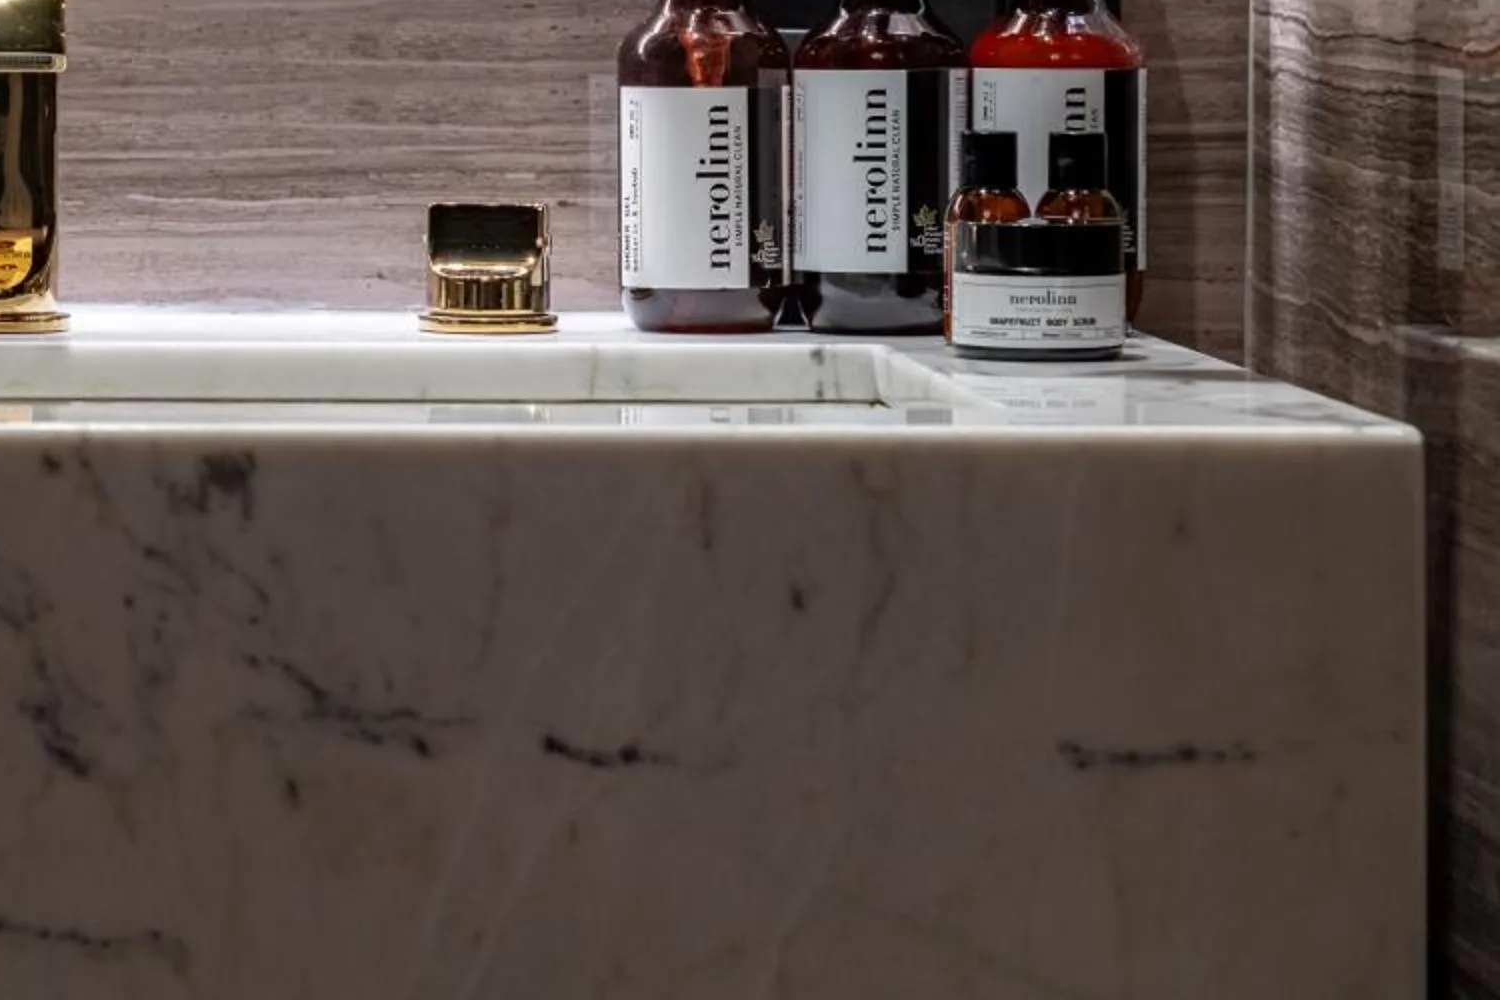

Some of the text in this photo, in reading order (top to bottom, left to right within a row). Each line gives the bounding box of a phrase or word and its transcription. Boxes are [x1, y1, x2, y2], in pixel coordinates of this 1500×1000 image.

[695, 103, 731, 272] nerolinn
[734, 125, 743, 247] SIMPLE NATURAL CLEAN
[852, 87, 887, 254] nerolinn
[891, 108, 901, 231] SIMPLE NATURAL CLEAN
[1009, 289, 1077, 305] nerolinn
